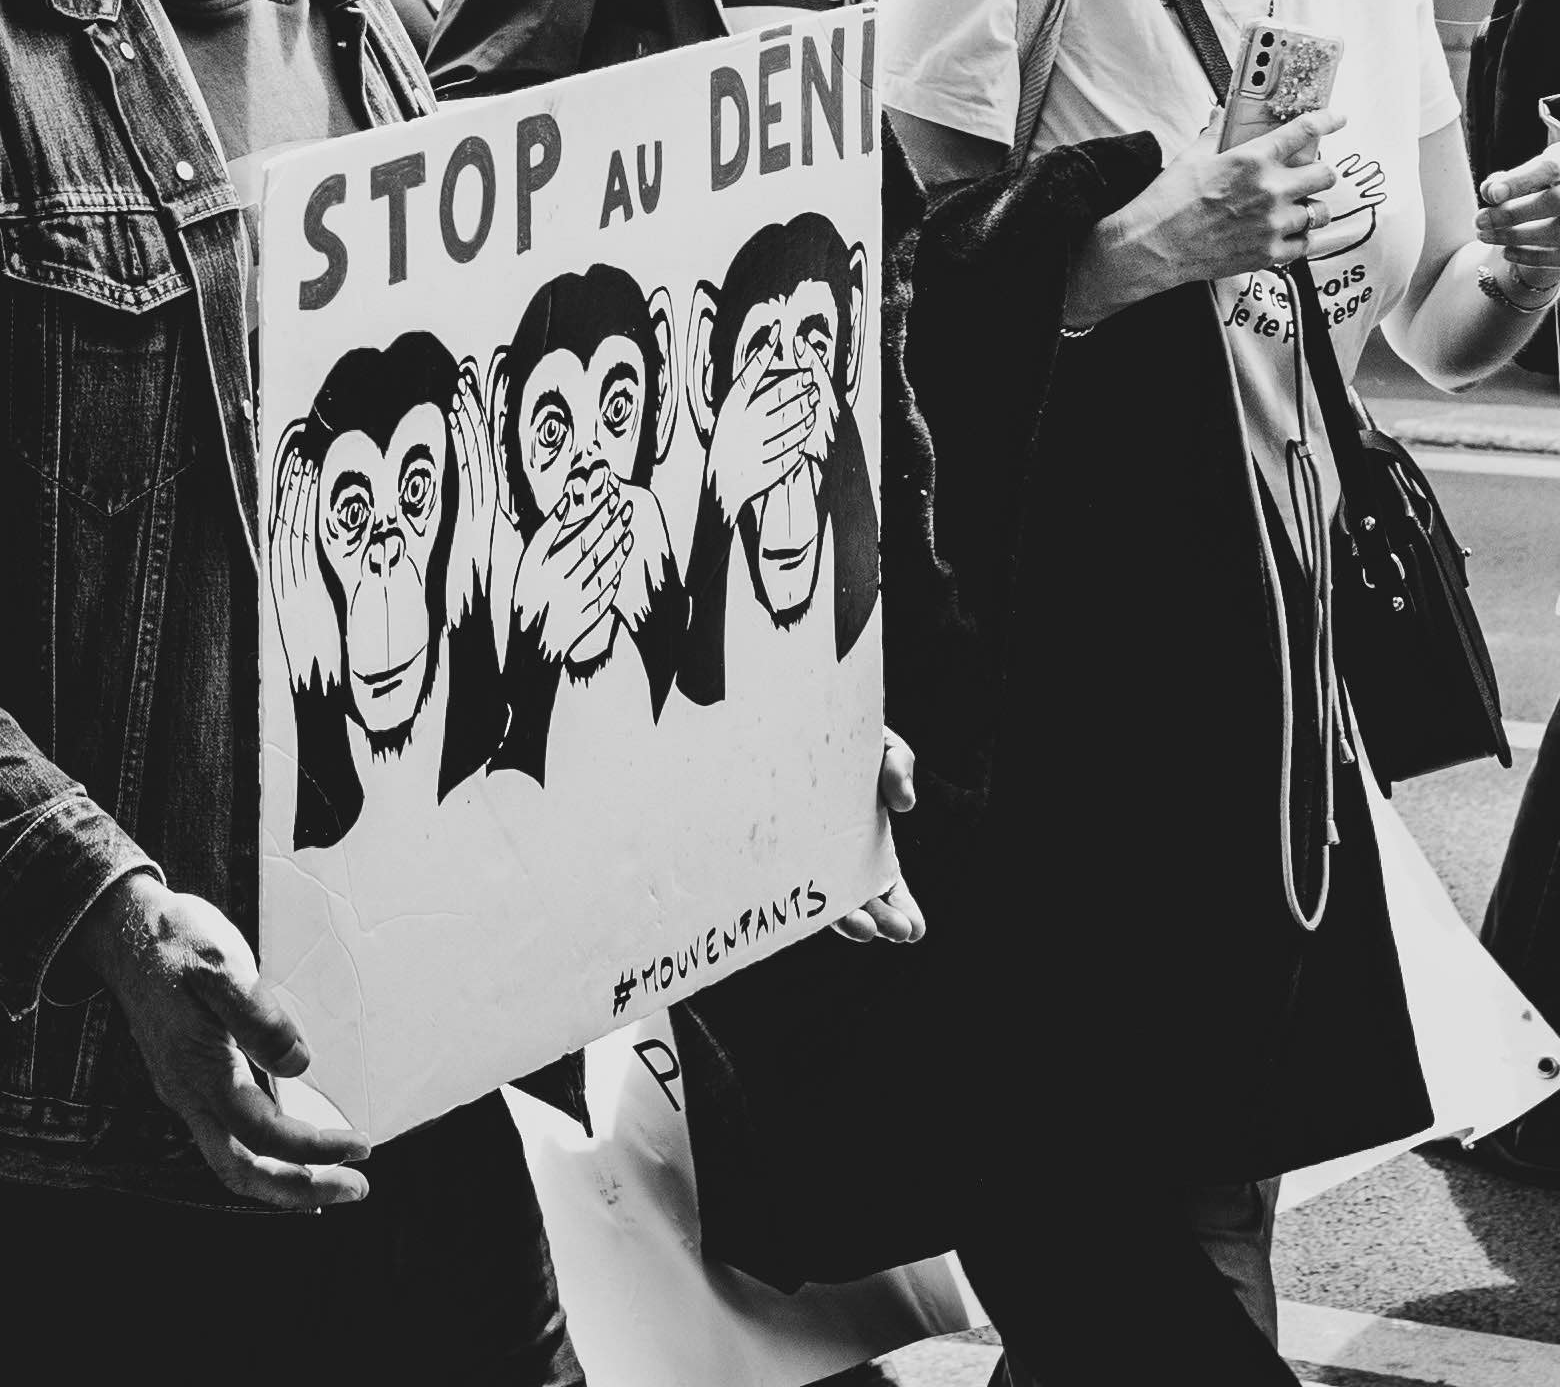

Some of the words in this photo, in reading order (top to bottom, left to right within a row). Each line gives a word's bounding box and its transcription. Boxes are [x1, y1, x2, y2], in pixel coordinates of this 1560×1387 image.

[299, 113, 562, 311] STOP
[600, 141, 663, 229] AU
[1316, 264, 1366, 297] ois
[1253, 312, 1280, 338] te
